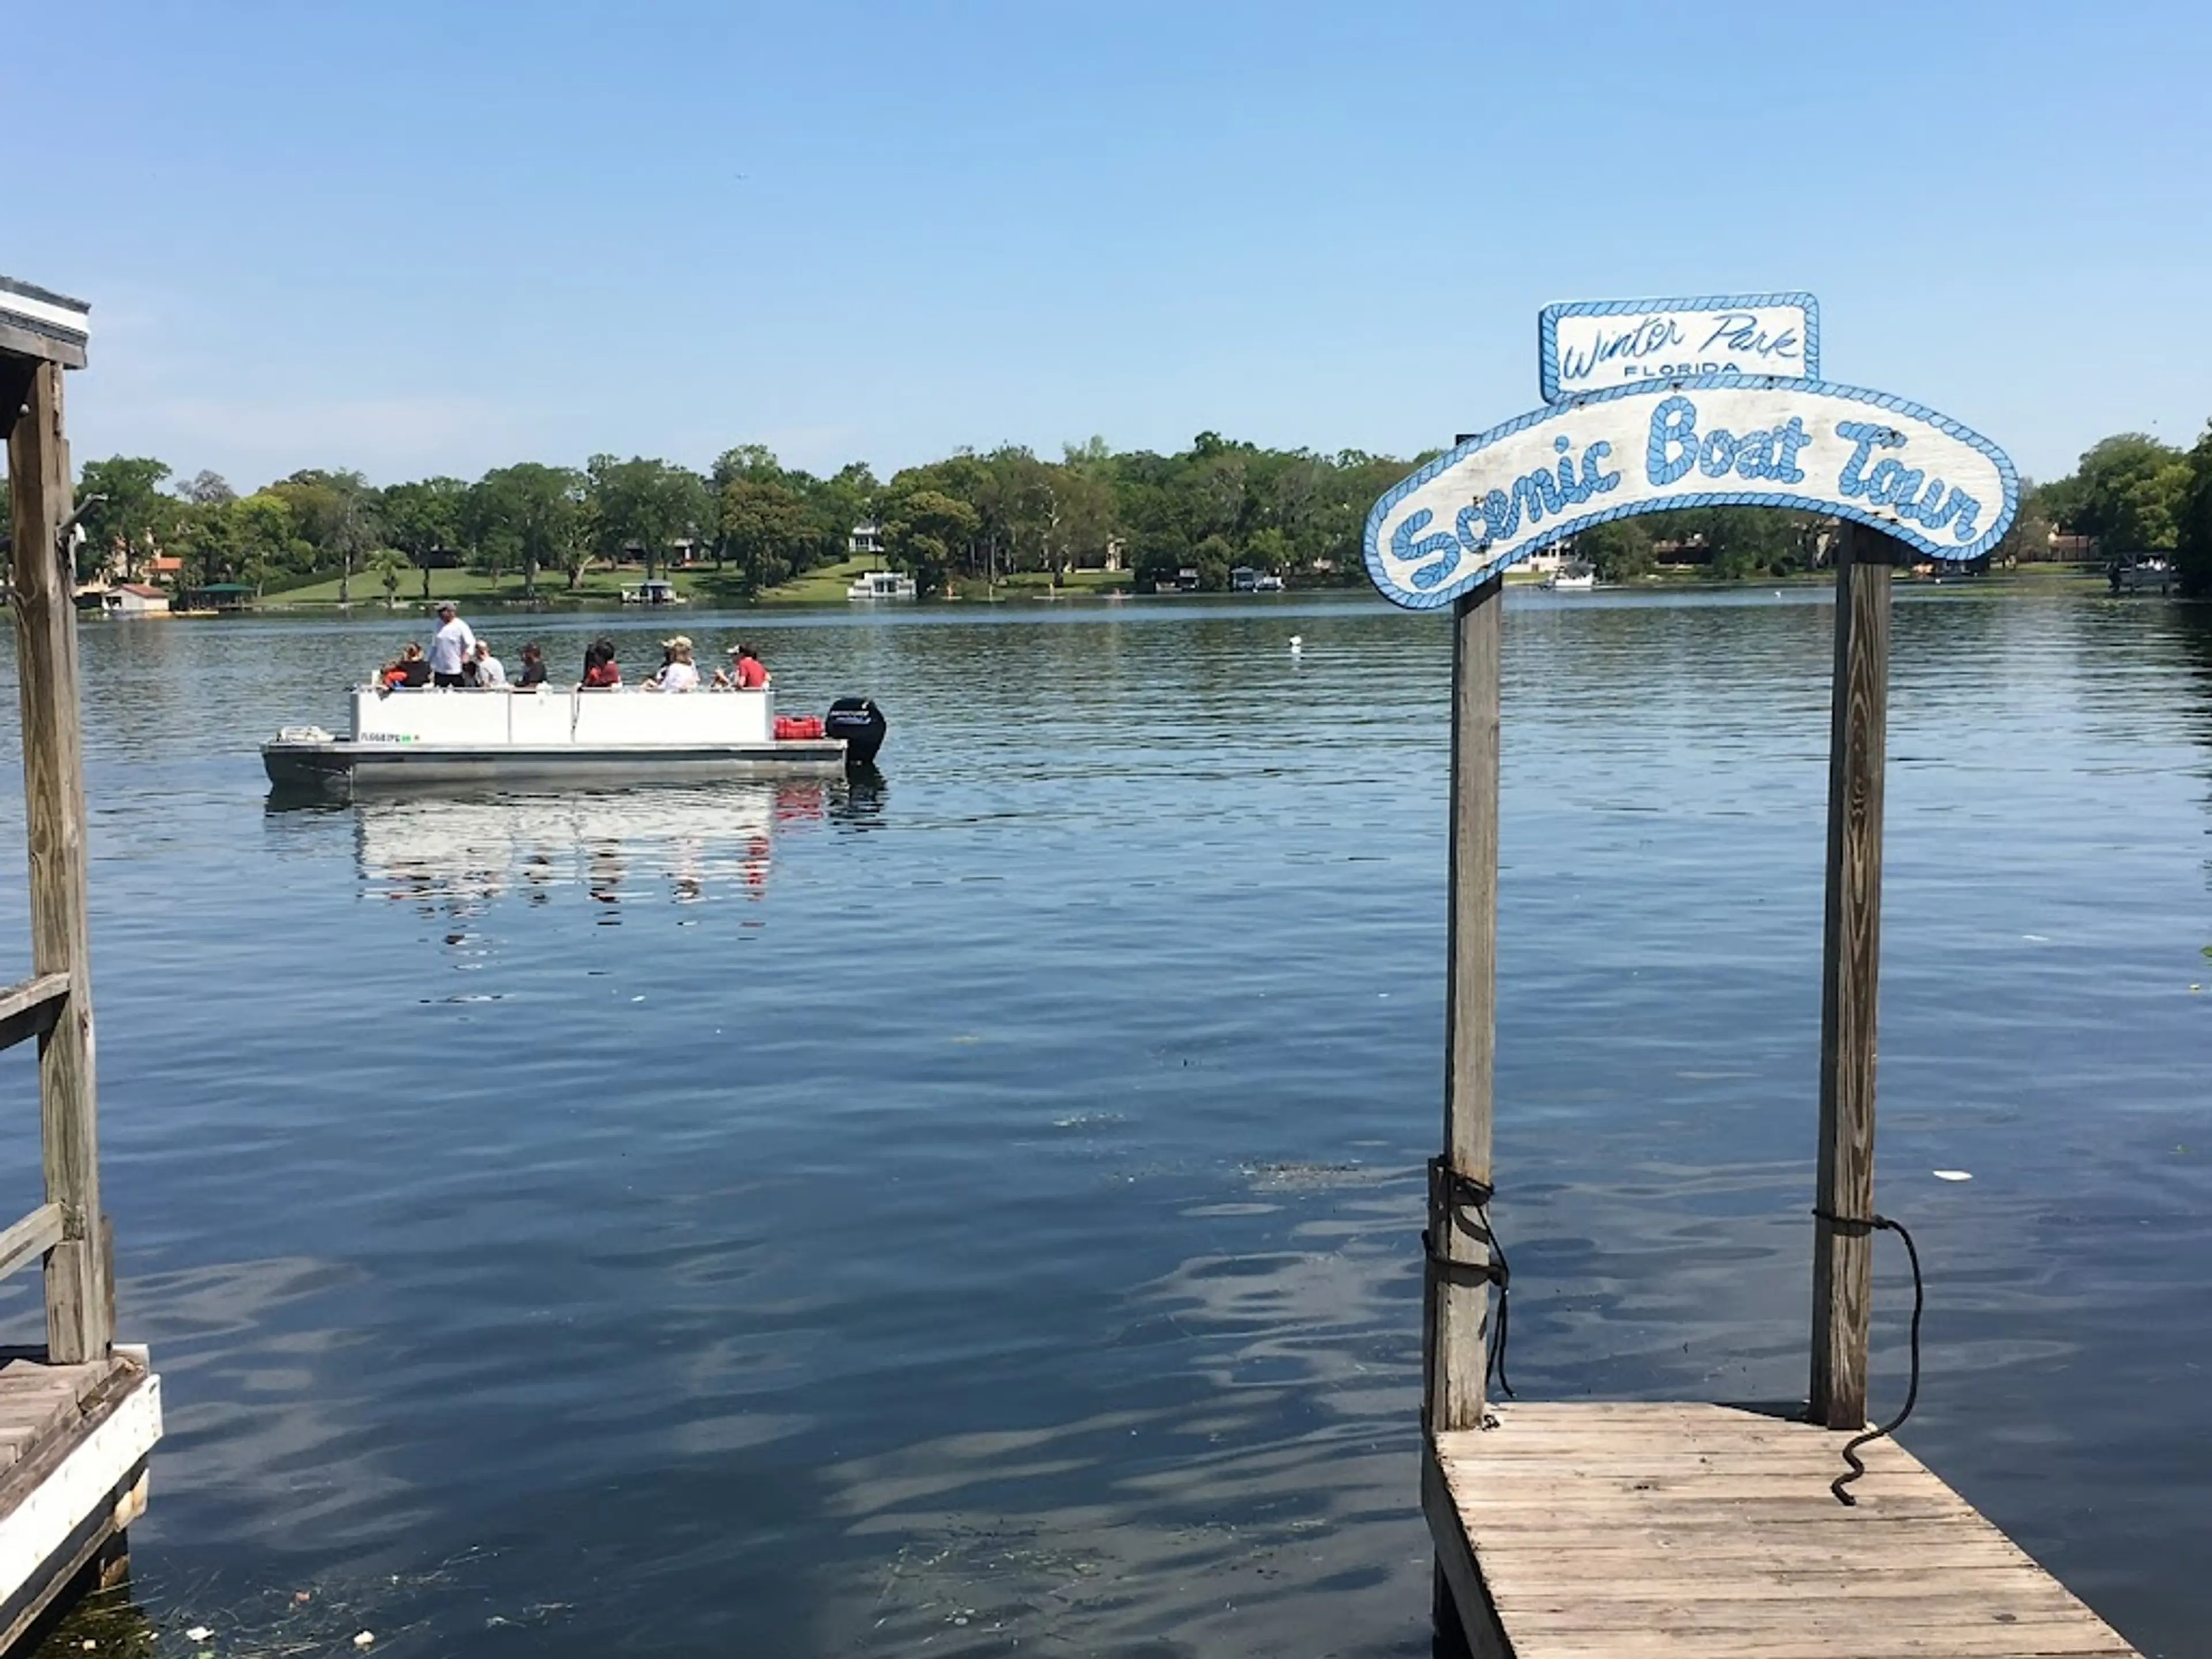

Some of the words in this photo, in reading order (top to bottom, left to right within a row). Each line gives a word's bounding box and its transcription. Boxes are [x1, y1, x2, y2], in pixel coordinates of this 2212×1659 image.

[1563, 316, 1685, 380] Winter
[1698, 313, 1800, 359] Park
[1624, 362, 1741, 377] FLORIDA
[1391, 435, 1621, 590] Scenic
[1646, 396, 1812, 487] Boat
[1835, 421, 1982, 541] Tour
